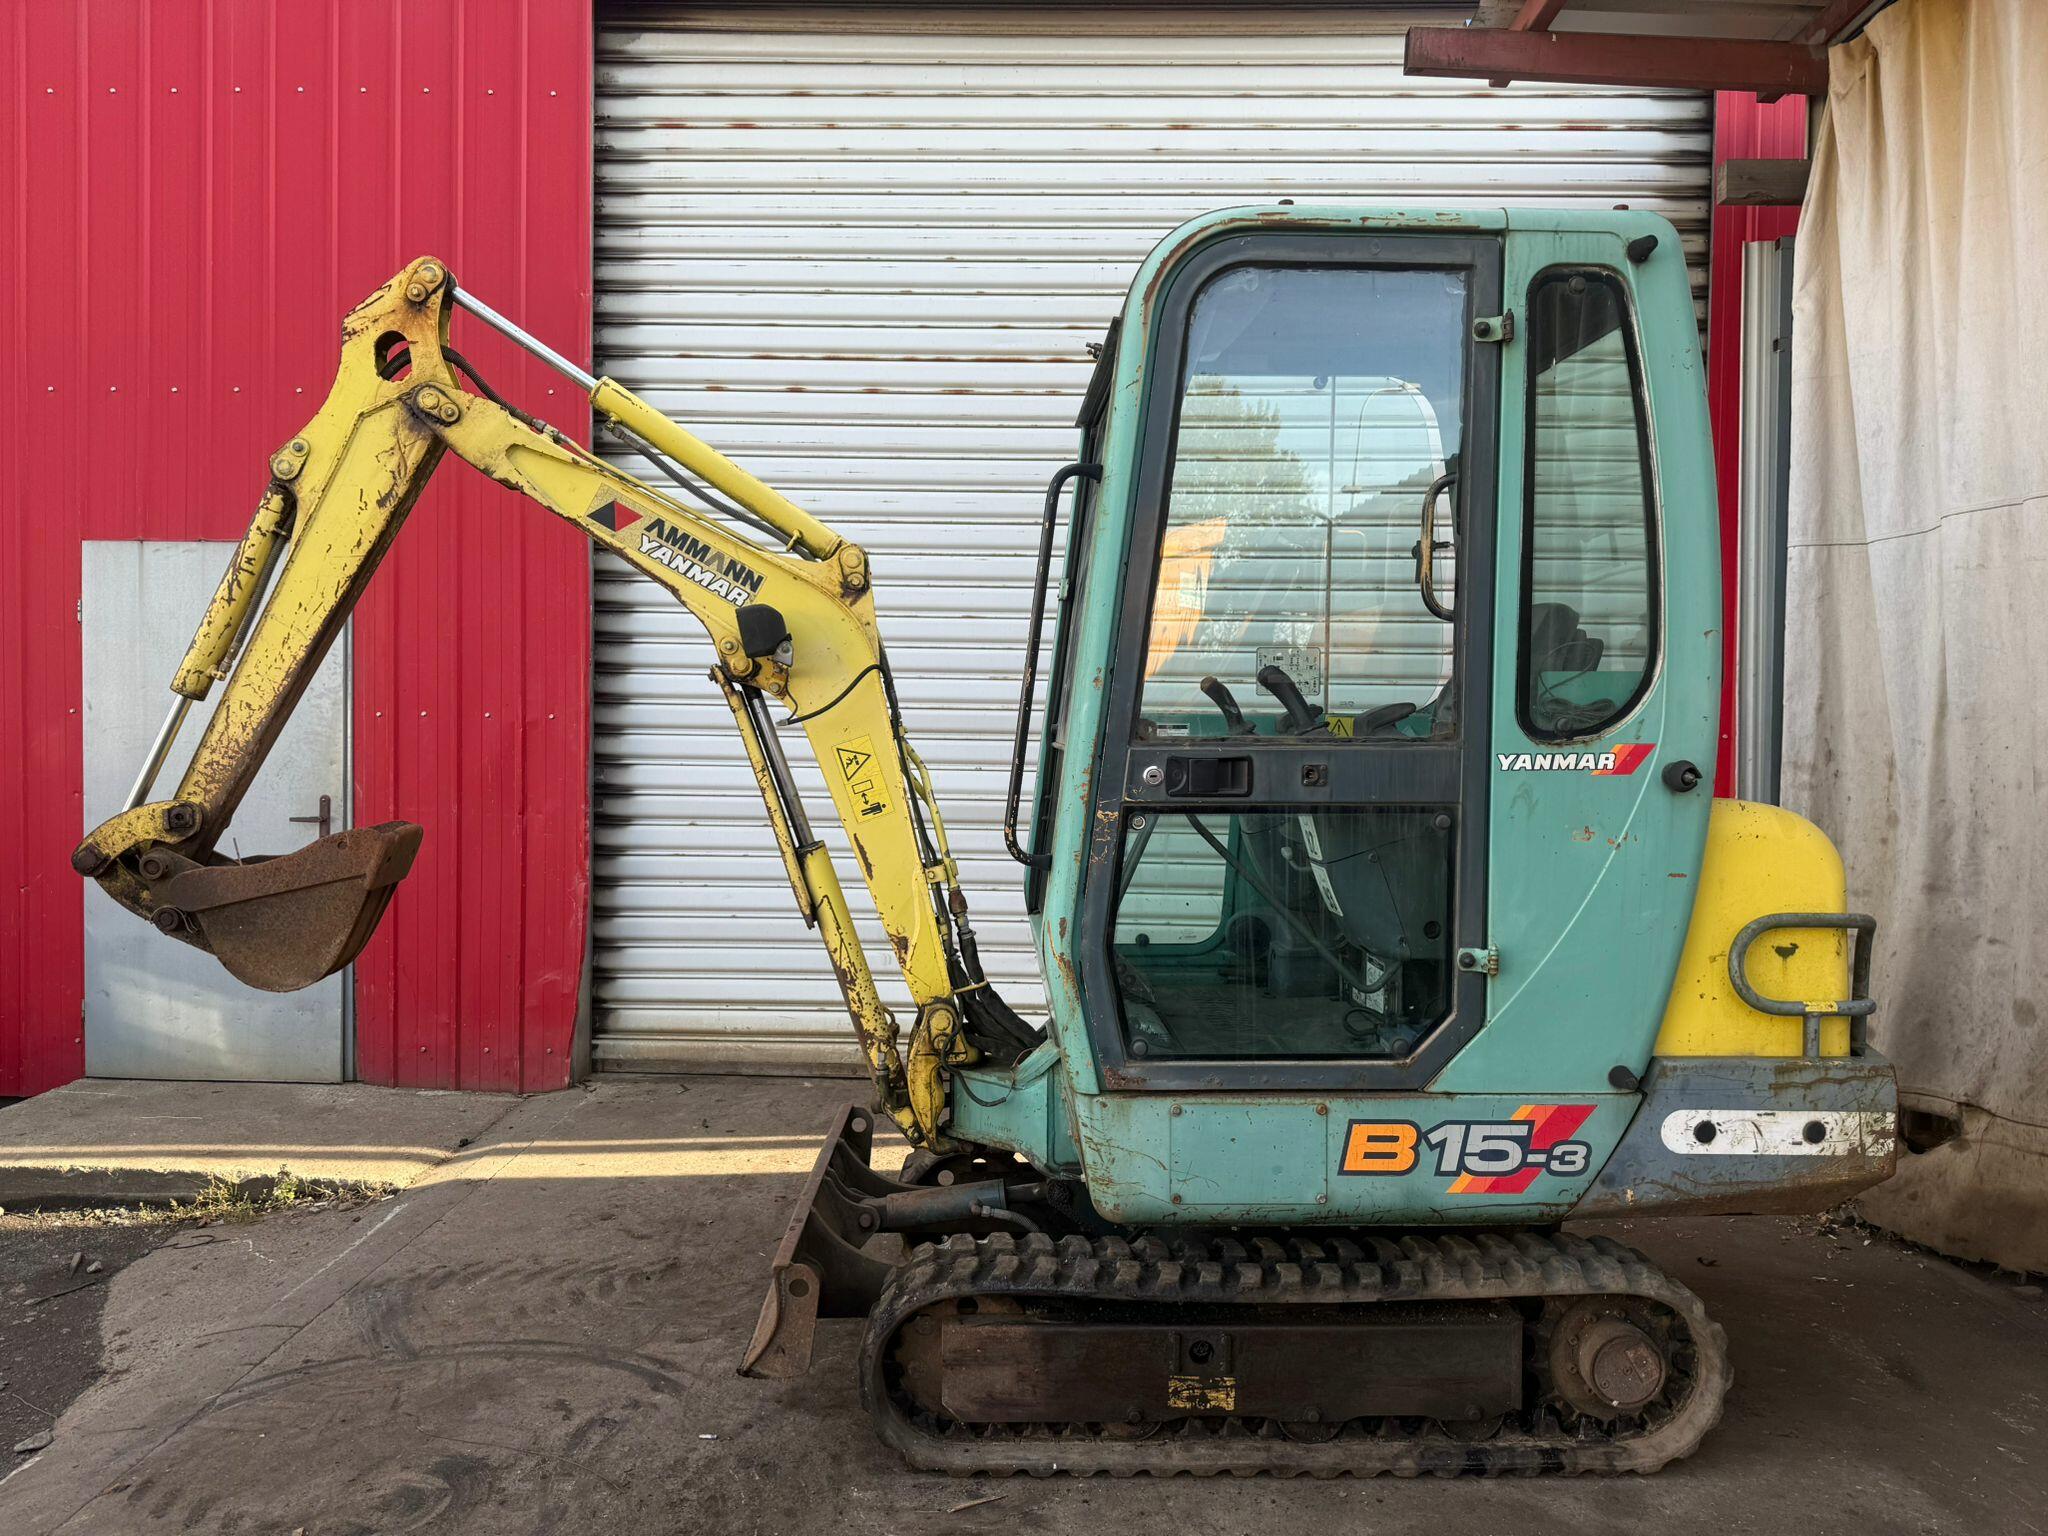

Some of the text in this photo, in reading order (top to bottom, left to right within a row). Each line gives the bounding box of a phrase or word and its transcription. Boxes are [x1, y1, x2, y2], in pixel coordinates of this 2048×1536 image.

[638, 533, 750, 607] YANMAR
[644, 518, 764, 593] AMMANN
[1497, 753, 1616, 771] YANMAR
